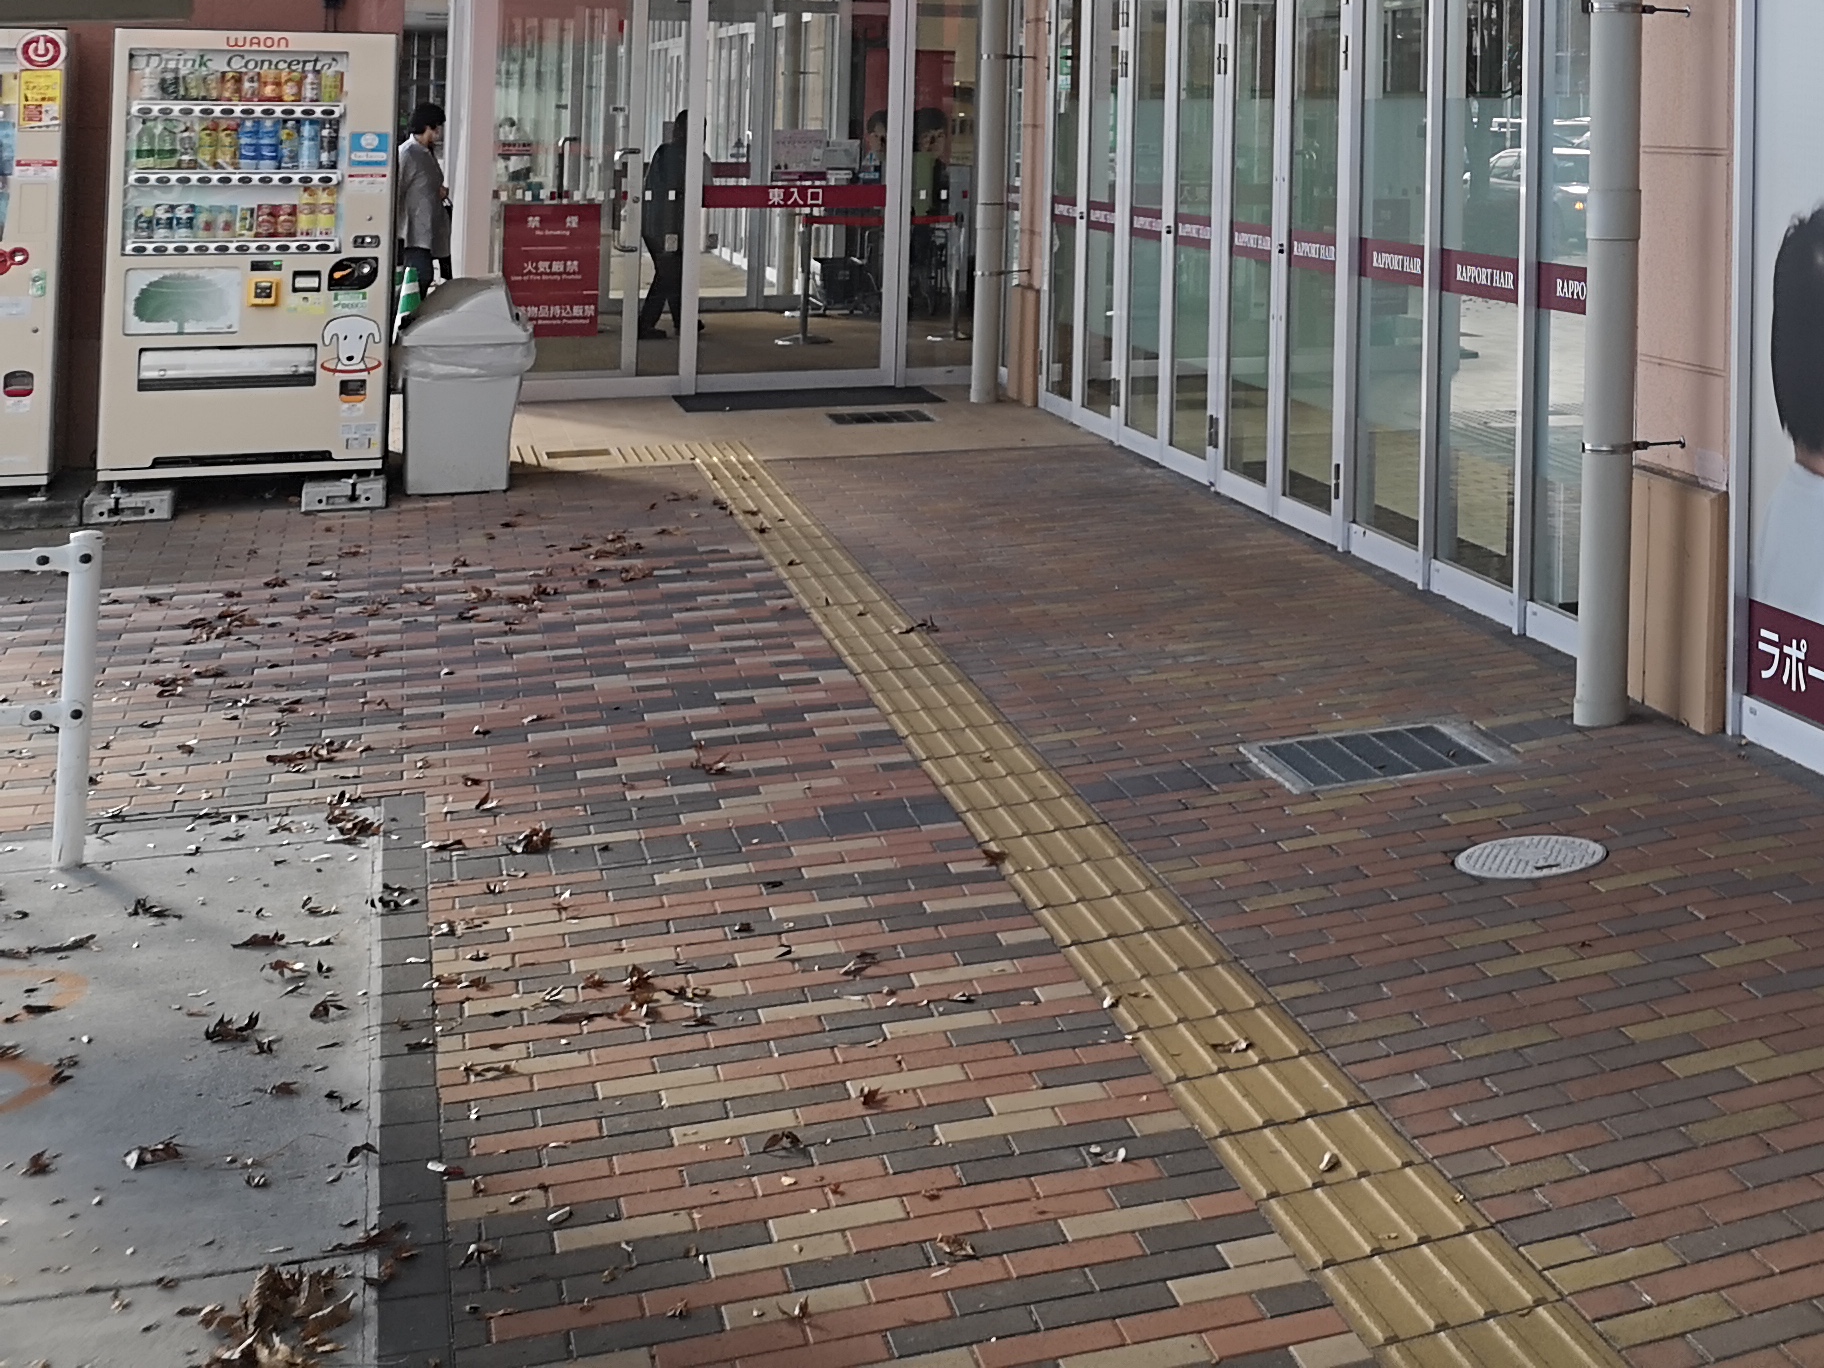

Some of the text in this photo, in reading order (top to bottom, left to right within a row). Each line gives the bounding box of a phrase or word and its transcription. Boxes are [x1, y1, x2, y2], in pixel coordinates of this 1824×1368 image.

[226, 36, 289, 48] WAON
[768, 189, 823, 205] 東入口
[523, 261, 579, 274] 火気厳禁
[1373, 251, 1421, 274] RAPPORT HAIR
[1457, 264, 1514, 289] RAPPORT HAIR
